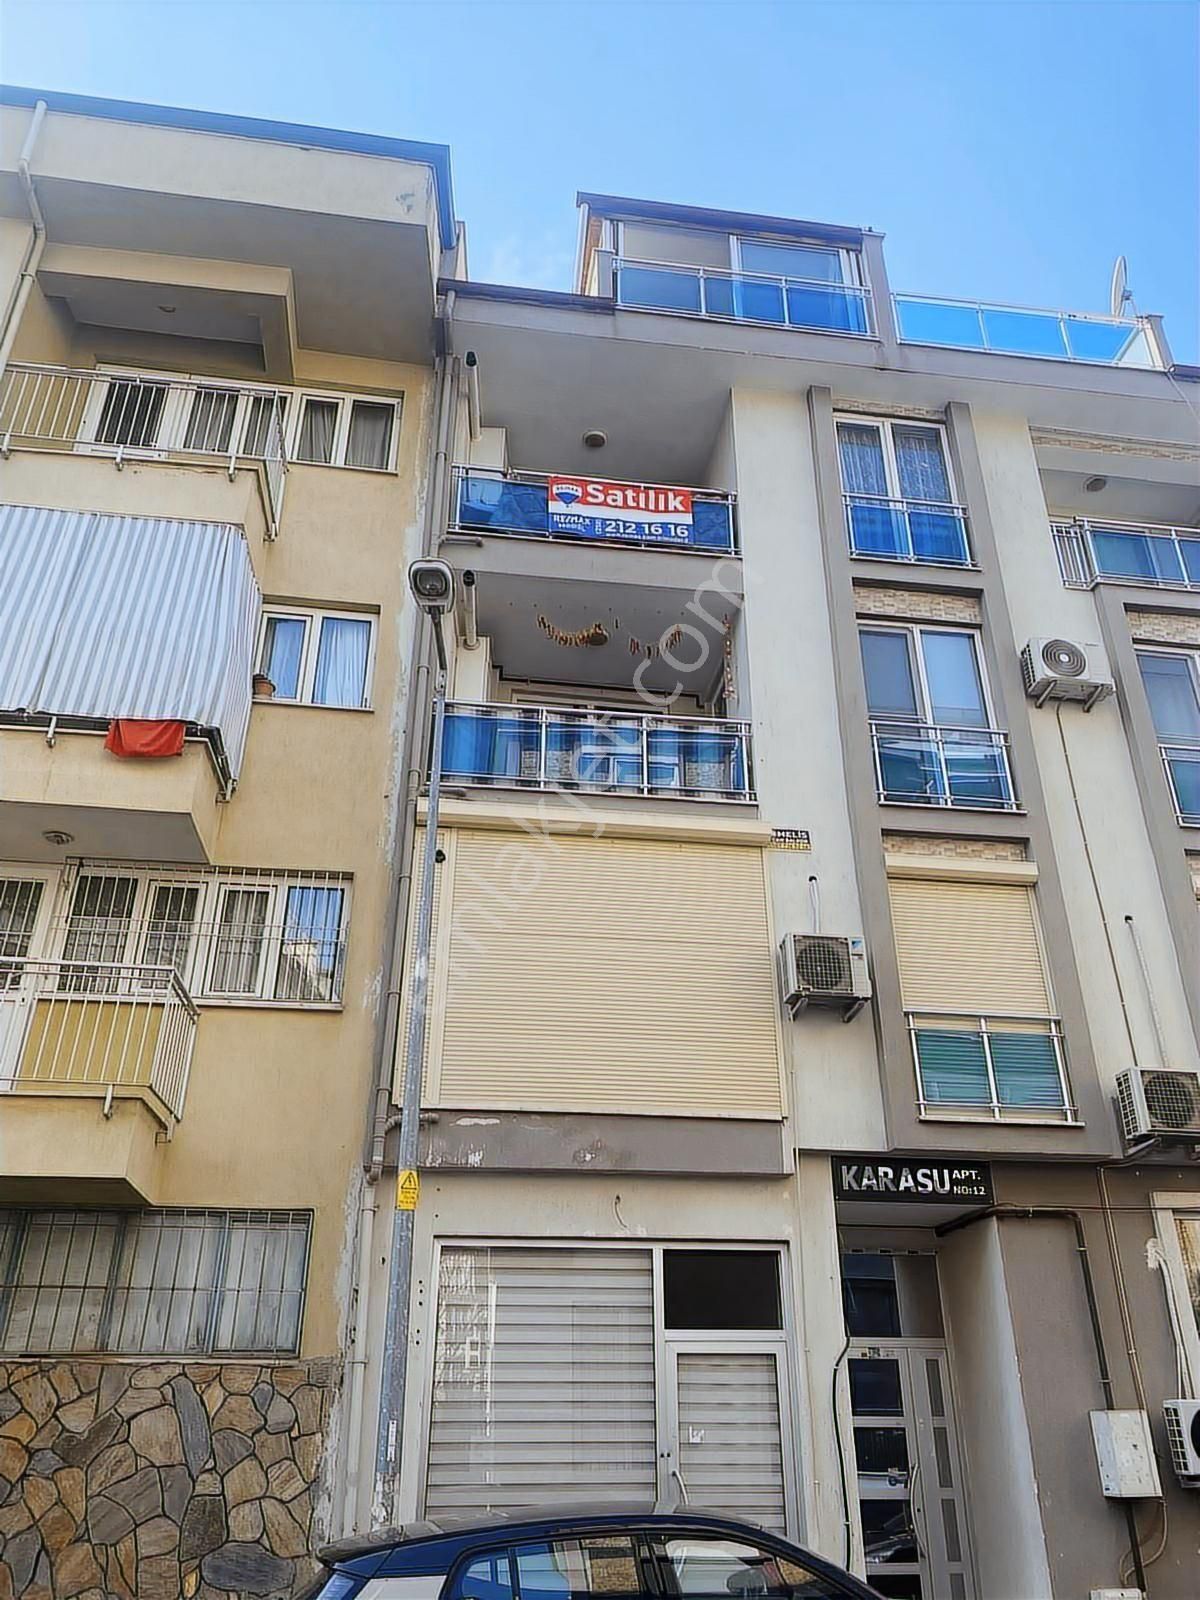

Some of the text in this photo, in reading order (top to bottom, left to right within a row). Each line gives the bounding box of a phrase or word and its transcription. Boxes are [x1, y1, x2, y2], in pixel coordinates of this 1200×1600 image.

[605, 520, 636, 533] 212
[641, 523, 663, 535] 16
[667, 524, 689, 537] 16
[841, 1165, 951, 1194] KARASU
[952, 1170, 981, 1180] APT.
[953, 1186, 986, 1195] NO:12
